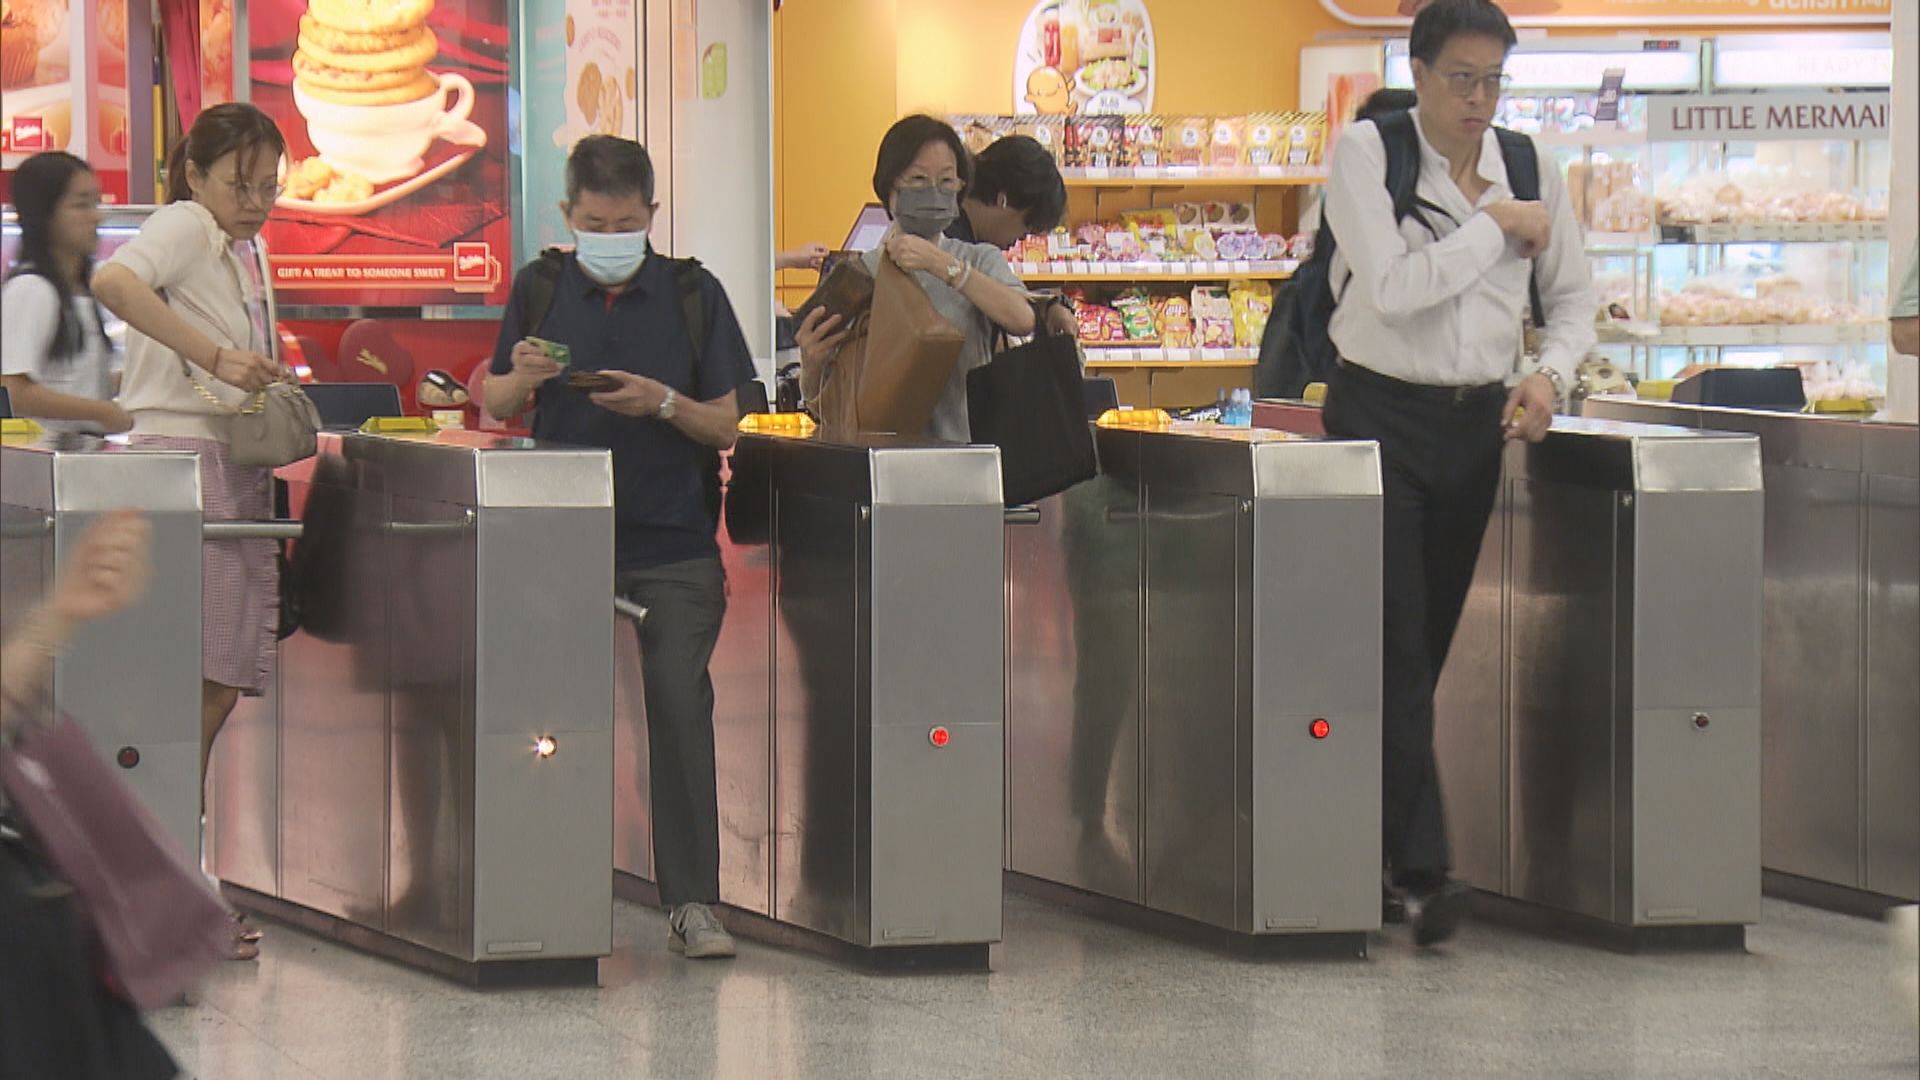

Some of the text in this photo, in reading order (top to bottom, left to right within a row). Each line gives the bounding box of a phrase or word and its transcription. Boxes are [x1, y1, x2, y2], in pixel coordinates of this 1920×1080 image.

[1672, 104, 1891, 130] LITTLE MERMAI
[277, 267, 446, 278] GIFT A TREAT TO SOMEONE SWEET
